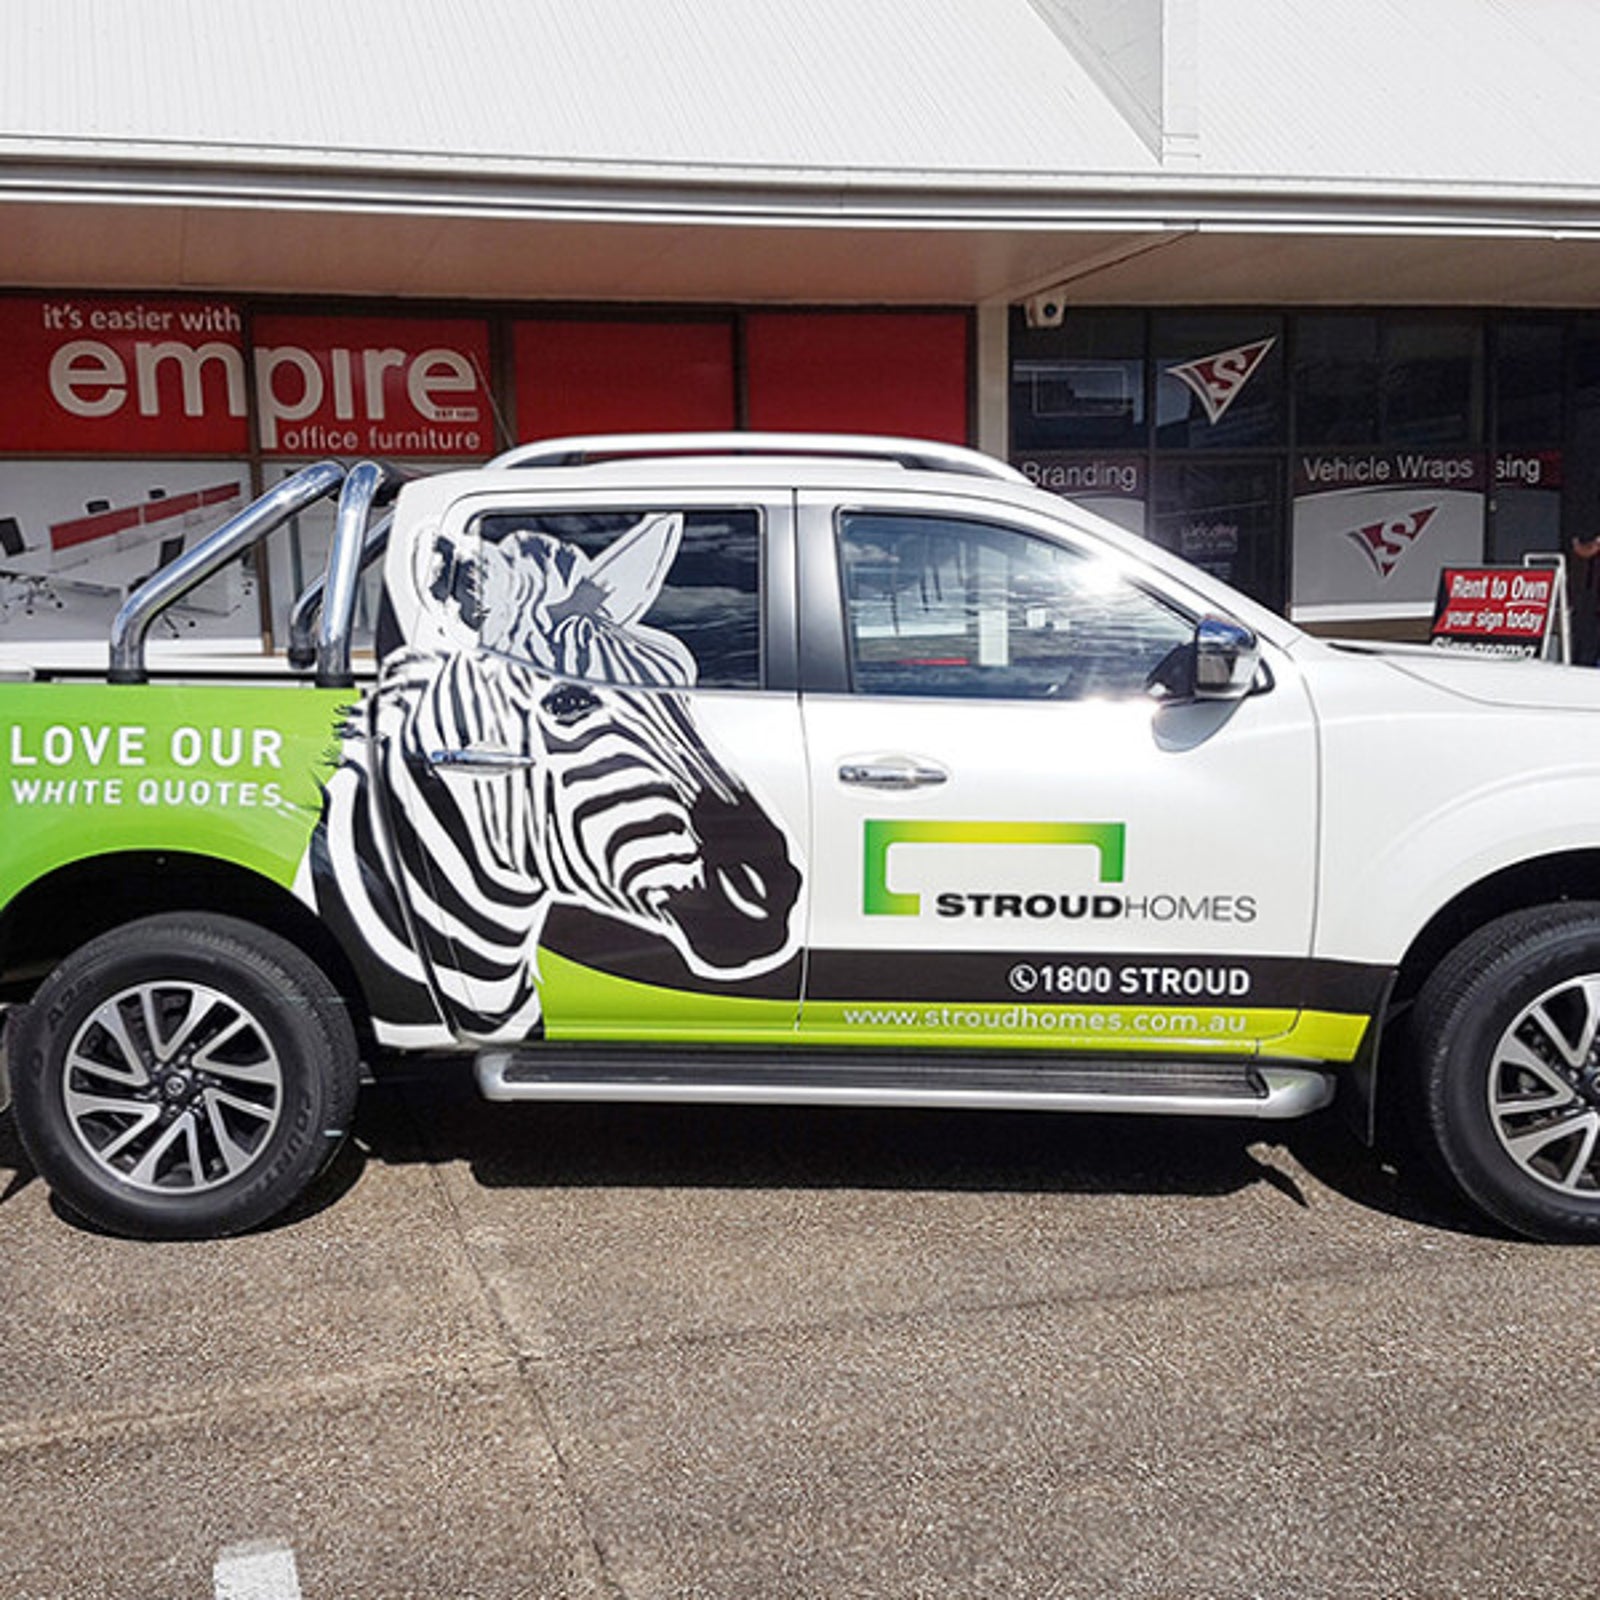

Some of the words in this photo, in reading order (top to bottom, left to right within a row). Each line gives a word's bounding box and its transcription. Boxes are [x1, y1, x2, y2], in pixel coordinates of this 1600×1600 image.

[43, 304, 83, 329] it's
[90, 305, 172, 330] easier
[180, 306, 241, 331] with
[49, 339, 478, 449] empire
[284, 426, 358, 449] office
[369, 427, 480, 449] furniture
[1022, 461, 1137, 491] Branding
[1303, 456, 1390, 481] Vehicle
[1397, 455, 1474, 483] Wraps
[1450, 575, 1489, 600] Rent
[1490, 576, 1508, 600] to
[1511, 575, 1549, 600] Own
[1444, 611, 1475, 630] your
[1475, 607, 1504, 632] sign
[1506, 609, 1544, 634] today
[10, 725, 146, 766] LOVE
[170, 726, 283, 768] OUR
[11, 778, 124, 804] WHITE
[1040, 965, 1111, 992] 1800
[1119, 967, 1250, 995] STROUD
[843, 1007, 1247, 1033] www.stroudhomes.com.au
